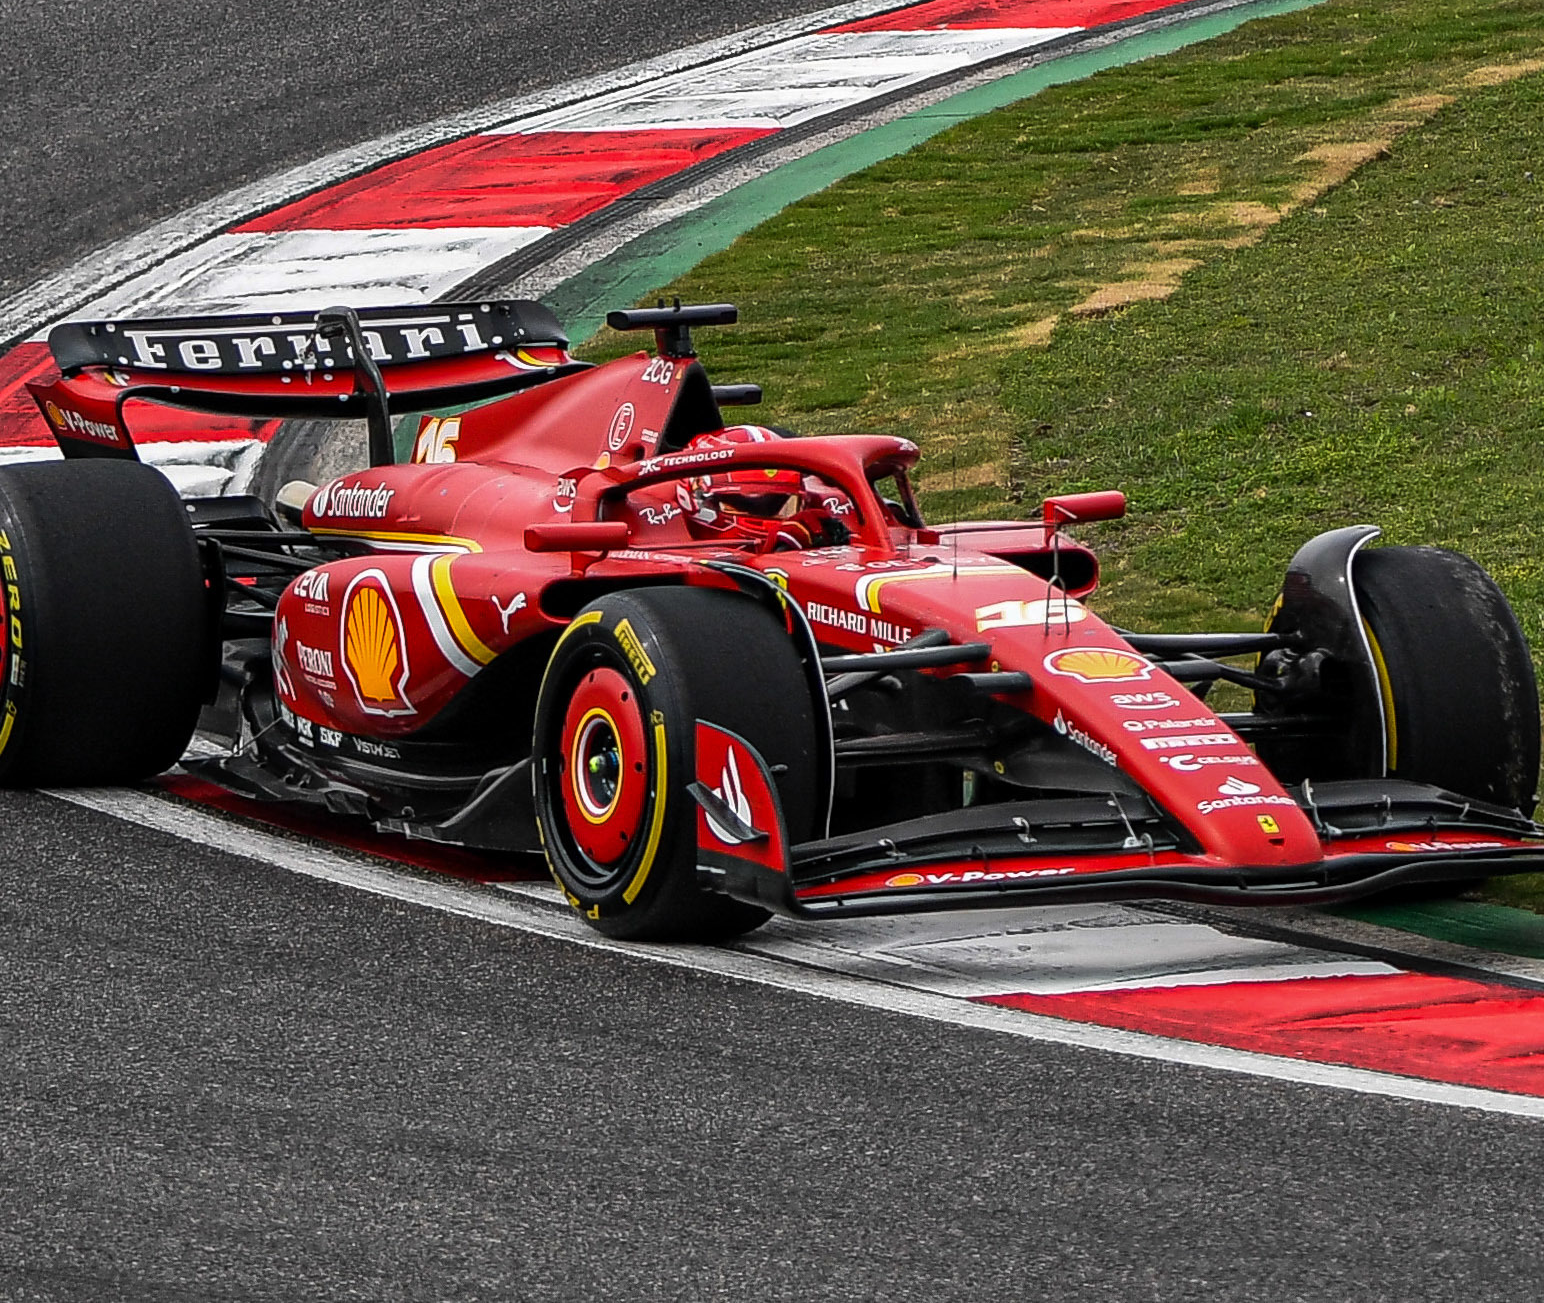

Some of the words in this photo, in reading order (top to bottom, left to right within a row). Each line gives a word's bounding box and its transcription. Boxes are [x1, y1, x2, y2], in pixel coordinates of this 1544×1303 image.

[124, 313, 489, 370] Ferrari
[60, 409, 120, 443] V-Power
[415, 416, 462, 464] 16
[664, 449, 735, 467] TECHNOLOGY
[327, 480, 395, 518] Santander
[806, 601, 867, 635] RICHARD
[870, 617, 913, 645] MILLE
[296, 639, 335, 678] PERONI
[613, 618, 657, 687] PIRELLI
[1110, 692, 1172, 705] aws
[319, 726, 343, 749] SKF
[1144, 717, 1217, 730] Palantir
[1066, 720, 1118, 768] Santander
[926, 867, 1076, 885] V-Power
